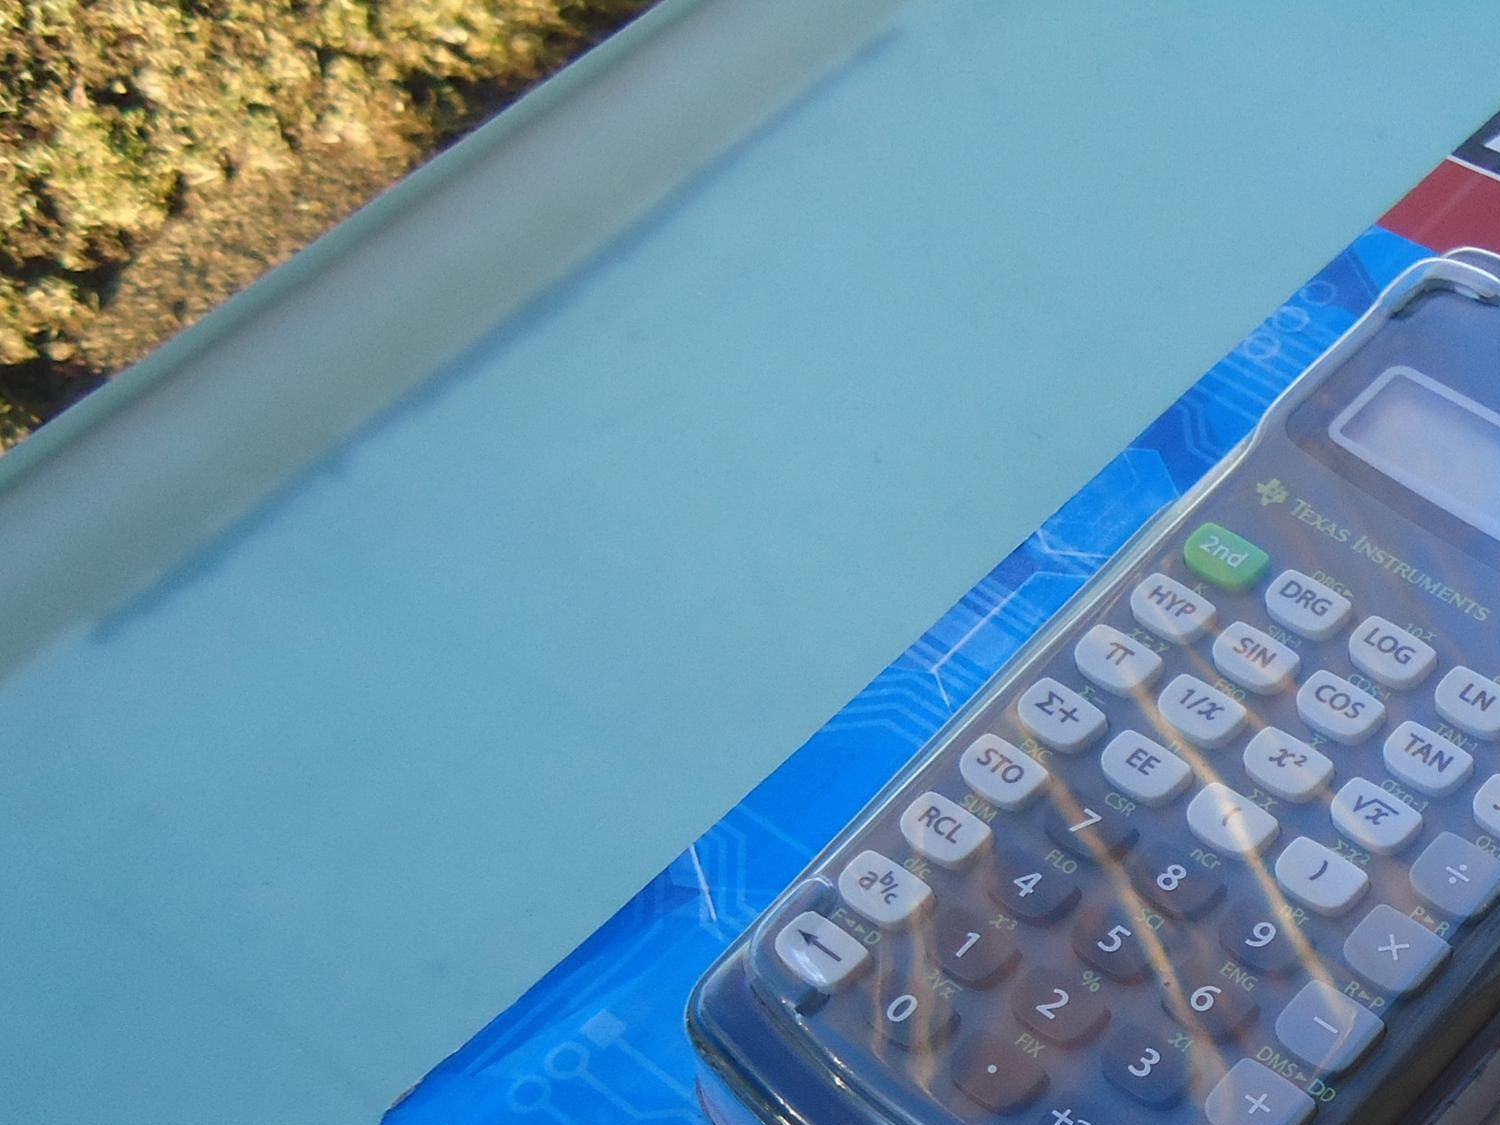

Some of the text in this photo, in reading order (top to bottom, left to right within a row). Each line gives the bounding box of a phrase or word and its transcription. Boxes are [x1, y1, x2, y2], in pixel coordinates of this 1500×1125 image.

[1201, 535, 1249, 568] 2nd
[1288, 499, 1491, 622] TEXAS INSTRUMENTS
[1147, 586, 1197, 617] HYP
[1279, 580, 1333, 617] DRG
[1232, 637, 1277, 669] SIN
[1363, 627, 1416, 665] LOG
[1315, 685, 1366, 719] COS
[1458, 683, 1496, 712] LN
[976, 747, 1025, 785] STO
[1125, 748, 1161, 776] EE
[1404, 733, 1454, 773] TAN
[1104, 792, 1137, 817] CSR
[918, 806, 964, 844] RCL
[1068, 808, 1104, 833] 7
[1044, 849, 1078, 875] FLO
[1013, 872, 1042, 897] 4
[1156, 864, 1187, 891] 8
[955, 931, 981, 958] 1
[1097, 924, 1132, 952] 5
[1244, 921, 1277, 948] 9
[1219, 961, 1259, 992] ENG
[886, 994, 919, 1022] 0
[1036, 988, 1069, 1020] 2
[1190, 985, 1222, 1012] 6
[1014, 1033, 1046, 1058] FIX
[1128, 1047, 1160, 1077] 3
